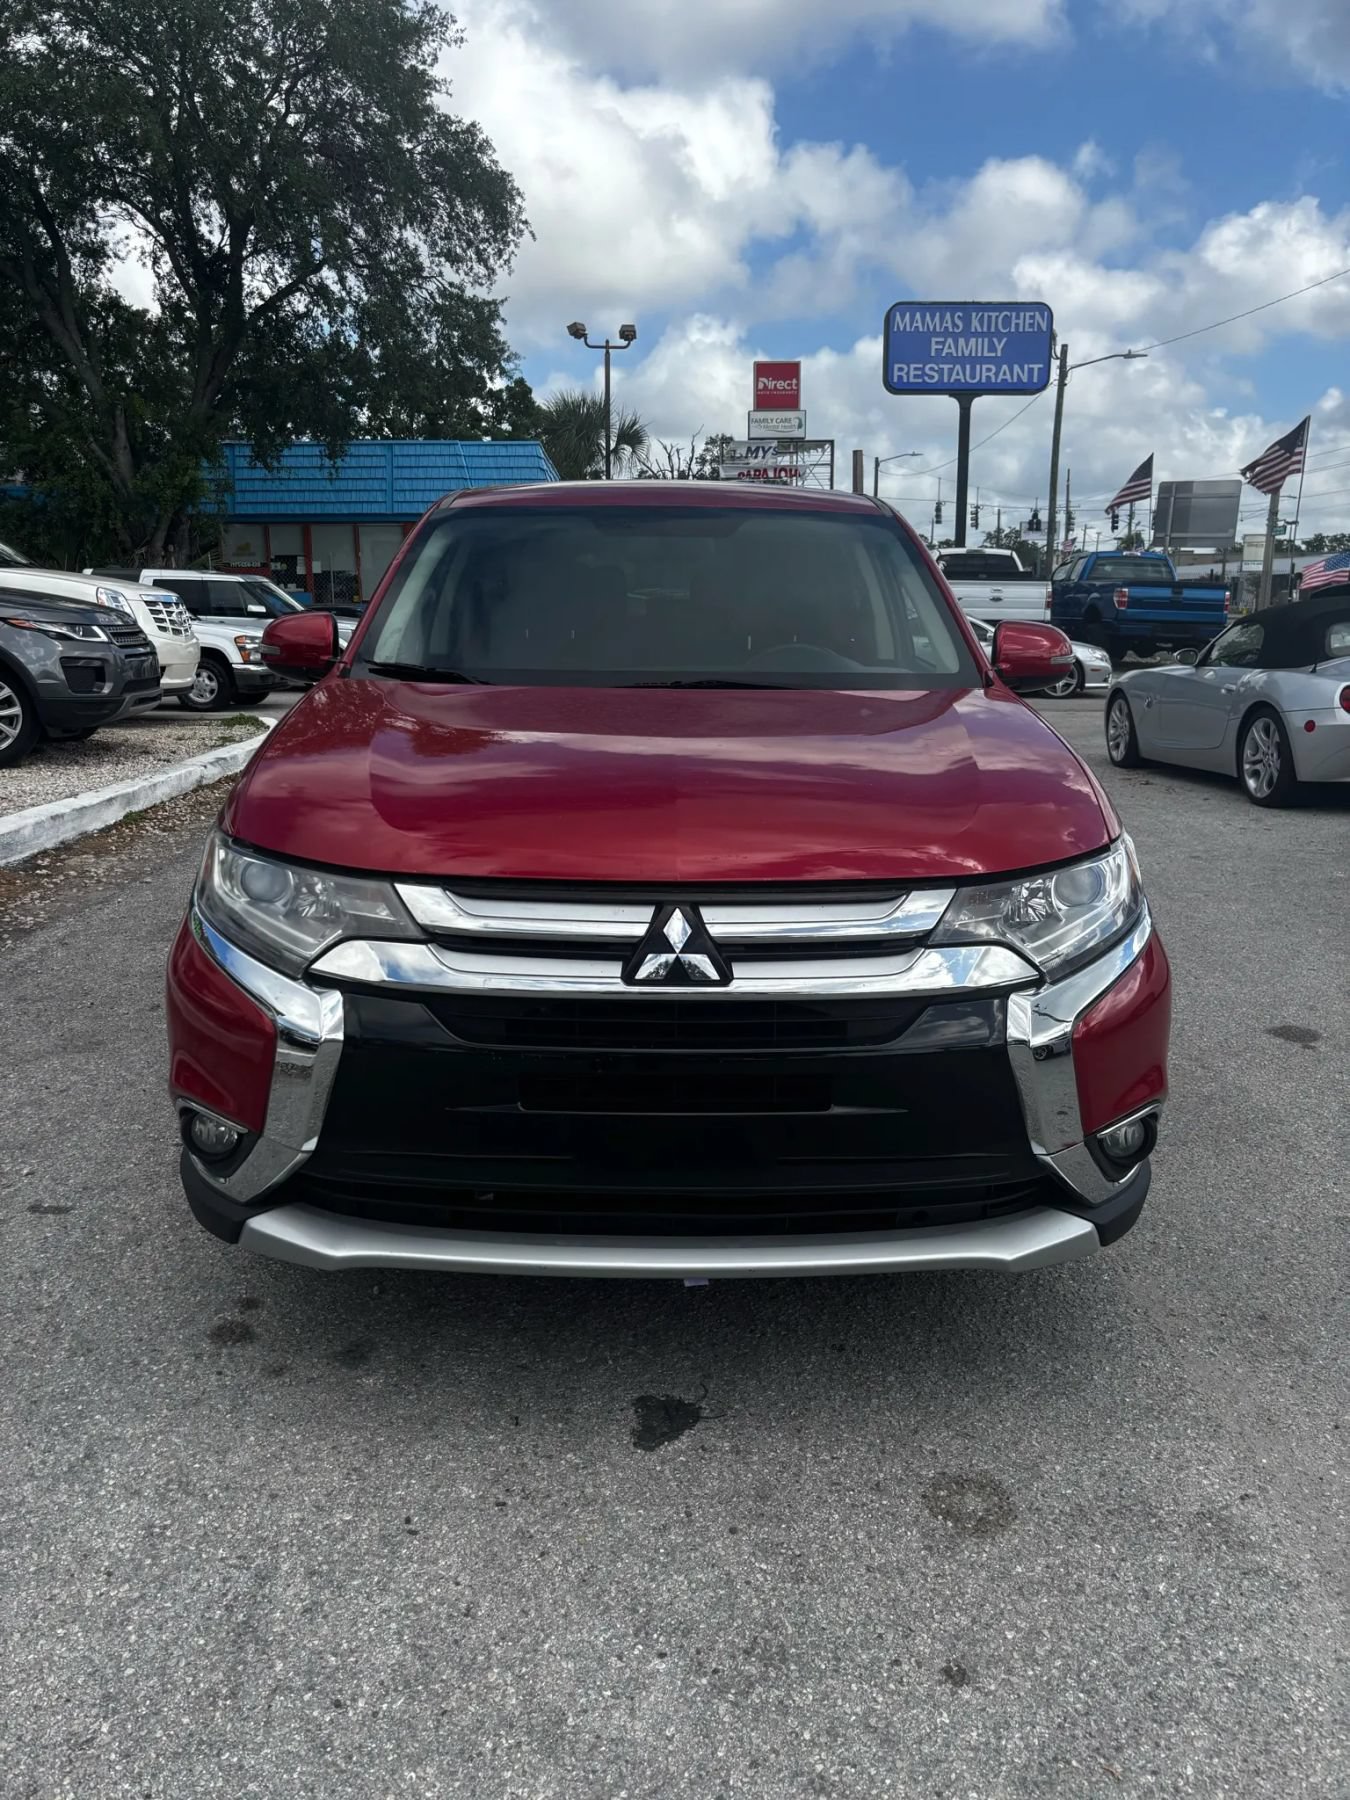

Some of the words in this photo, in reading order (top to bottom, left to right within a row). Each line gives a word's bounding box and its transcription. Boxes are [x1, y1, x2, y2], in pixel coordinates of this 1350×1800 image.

[893, 311, 964, 333] MAMAS
[970, 311, 1048, 333] KITCHEN
[930, 337, 1008, 357] FAMILY
[893, 363, 1044, 383] RESTAURANT
[757, 377, 798, 390] Direct
[751, 417, 775, 425] FAMILY
